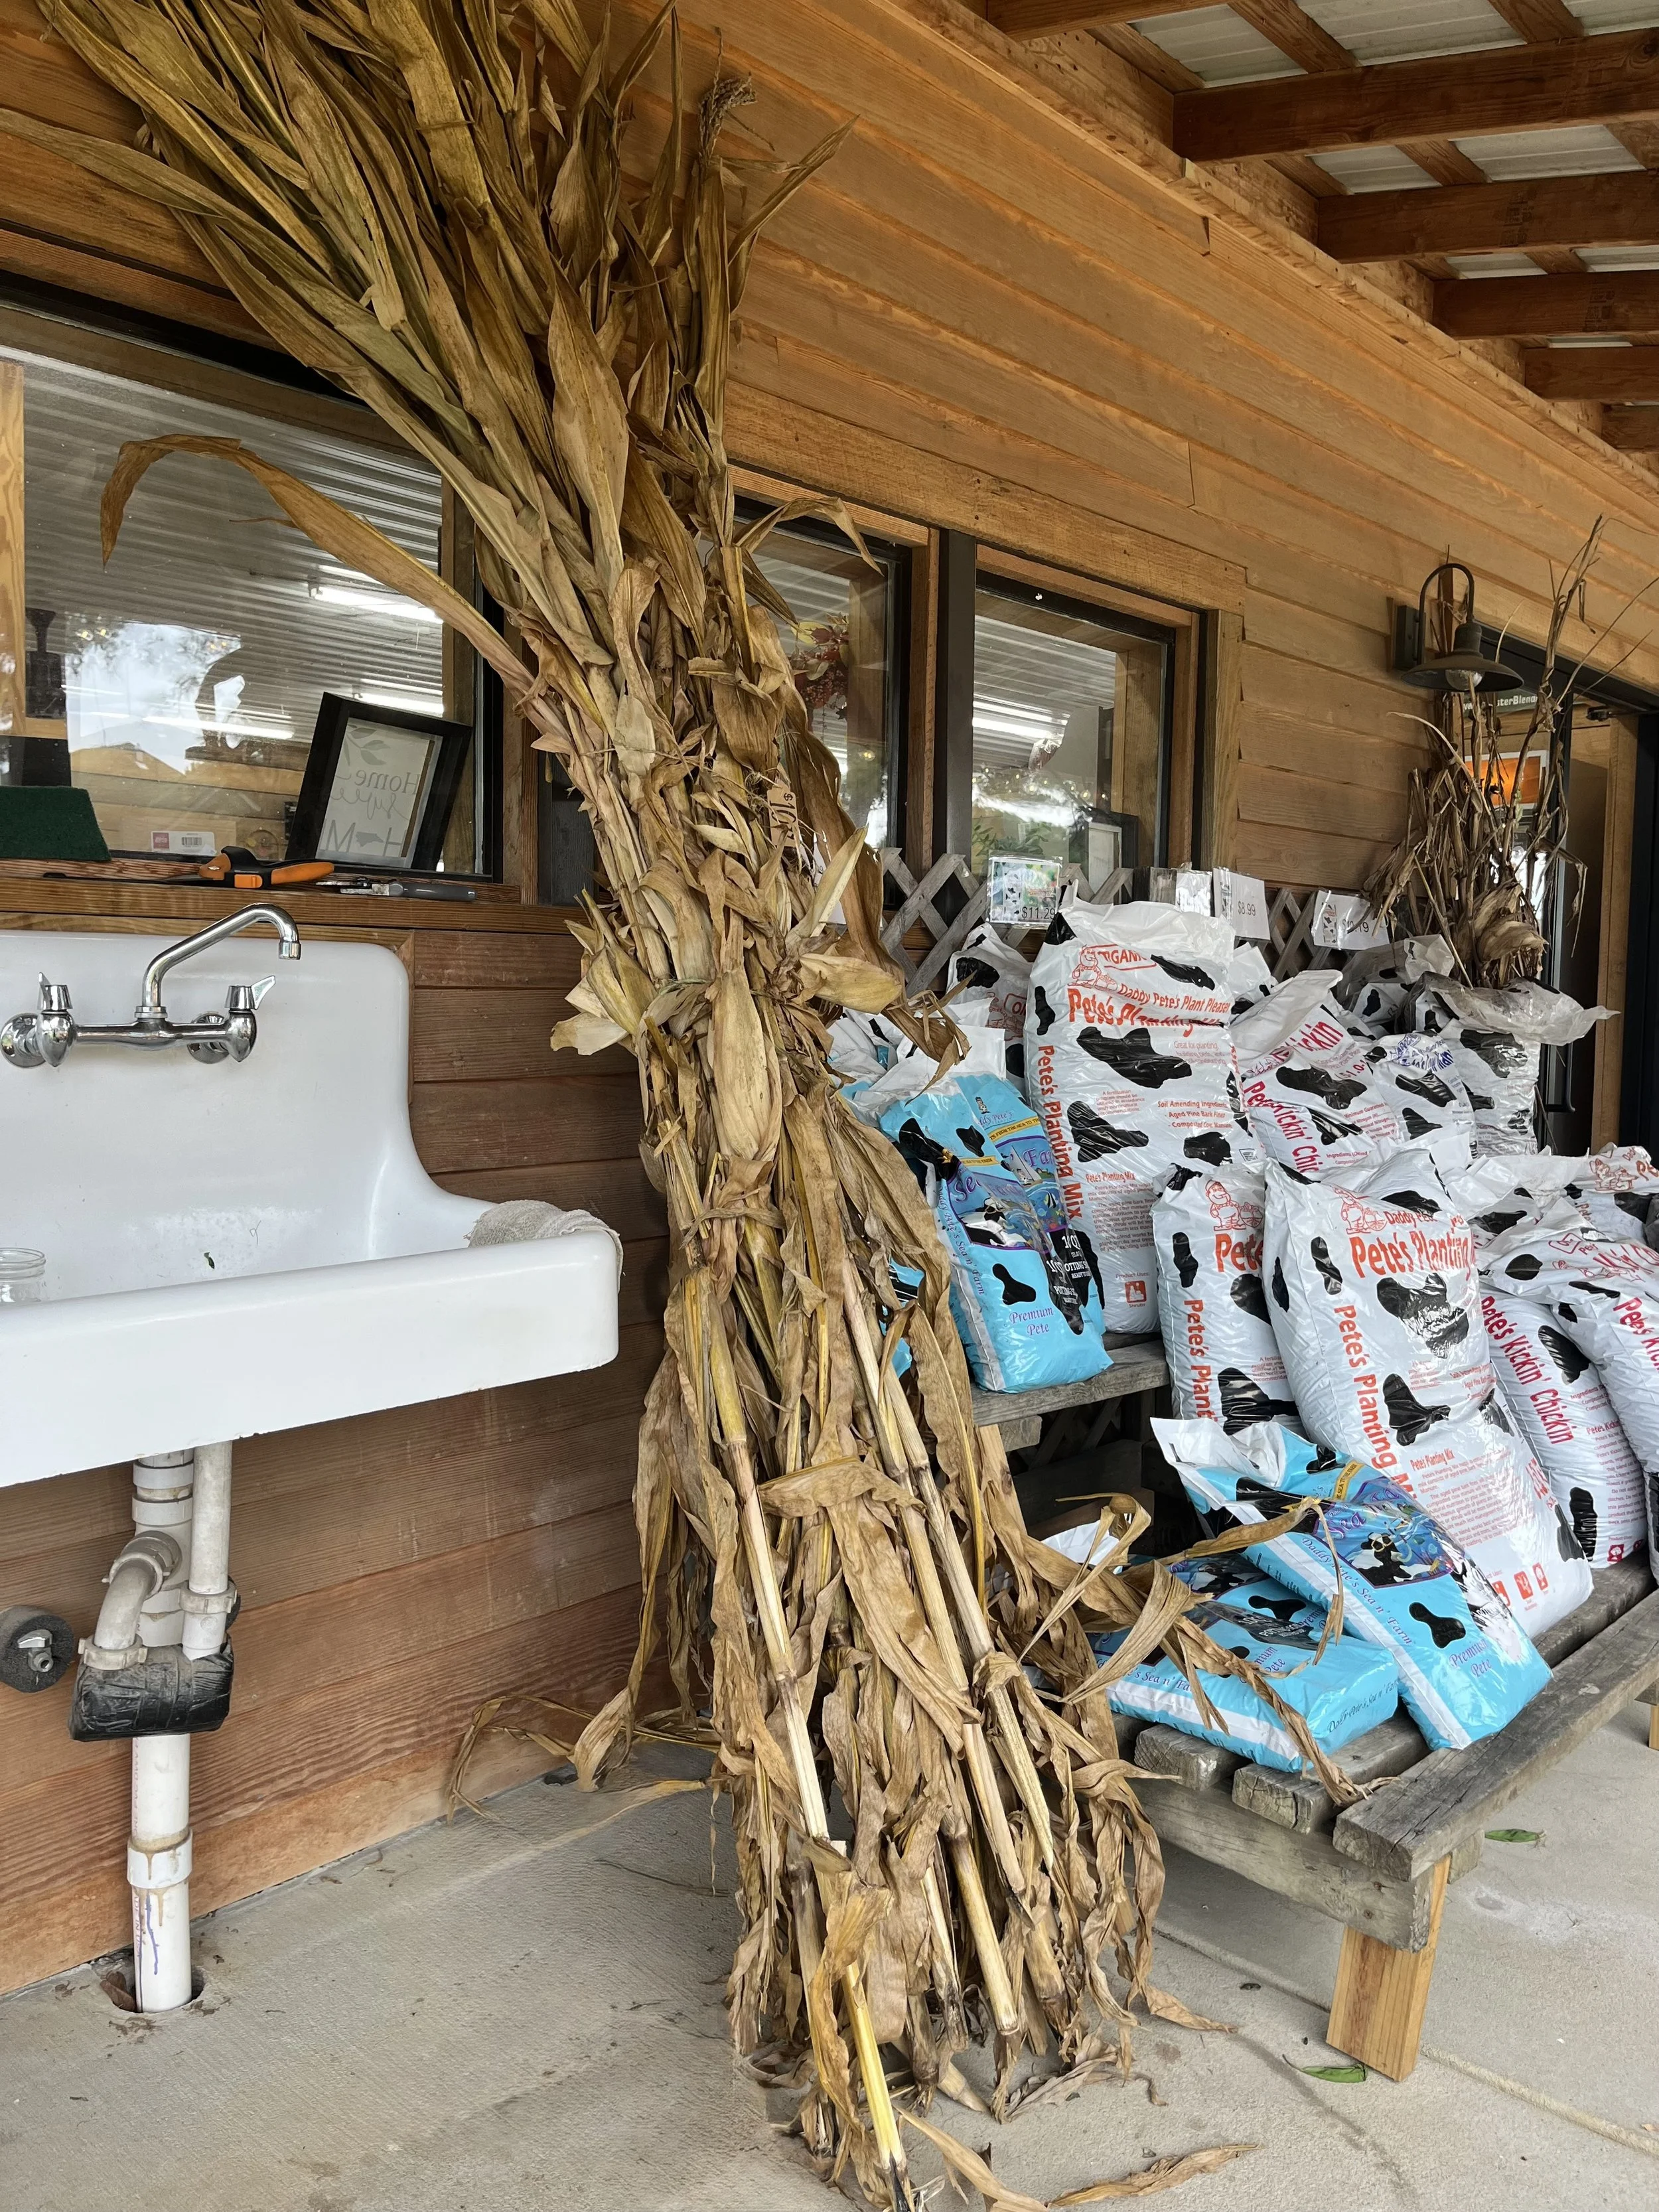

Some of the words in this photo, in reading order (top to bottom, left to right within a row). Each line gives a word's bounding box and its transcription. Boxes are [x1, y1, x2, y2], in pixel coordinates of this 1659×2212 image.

[1021, 906, 1055, 920] $11.29
[1238, 901, 1256, 917] $8.99
[1067, 988, 1114, 1025] Pete's
[1118, 984, 1151, 1005] Daddy
[1153, 993, 1180, 1009] Pete's
[1183, 995, 1204, 1011] Plant
[1038, 1045, 1058, 1096] Pete's
[1043, 1100, 1074, 1179] Planting
[1086, 1173, 1101, 1183] Pete's
[1102, 1171, 1126, 1183] Planting
[1125, 1171, 1136, 1180] Mix
[1063, 1183, 1084, 1220] Mix
[1384, 1211, 1417, 1228] Daddy
[956, 1240, 968, 1257] Sea
[972, 1268, 985, 1295] Farm
[1349, 1232, 1413, 1278] Pete's
[1409, 1230, 1471, 1281] Planting
[1009, 1307, 1054, 1324] Premium
[1027, 1323, 1049, 1336] Pete
[1184, 1299, 1209, 1359] Pete's
[1481, 1295, 1518, 1340] Pete's
[1499, 1335, 1552, 1386] Kickin'
[1334, 1305, 1370, 1368] Pete's
[1354, 1374, 1398, 1469] Planting
[1530, 1388, 1577, 1444] Chickin
[1587, 1425, 1604, 1436] Pete's
[1411, 1458, 1426, 1471] Pete's
[1425, 1451, 1447, 1465] Planting
[1444, 1448, 1455, 1461] Mix
[1302, 1538, 1331, 1563] Daddy
[1357, 1587, 1376, 1605] Sea
[1375, 1605, 1391, 1614] n'
[1387, 1617, 1413, 1645] Farm
[1449, 1638, 1489, 1668] Premium
[1471, 1659, 1492, 1678] Pete
[1141, 1671, 1161, 1684] Sea
[1163, 1676, 1175, 1686] n'
